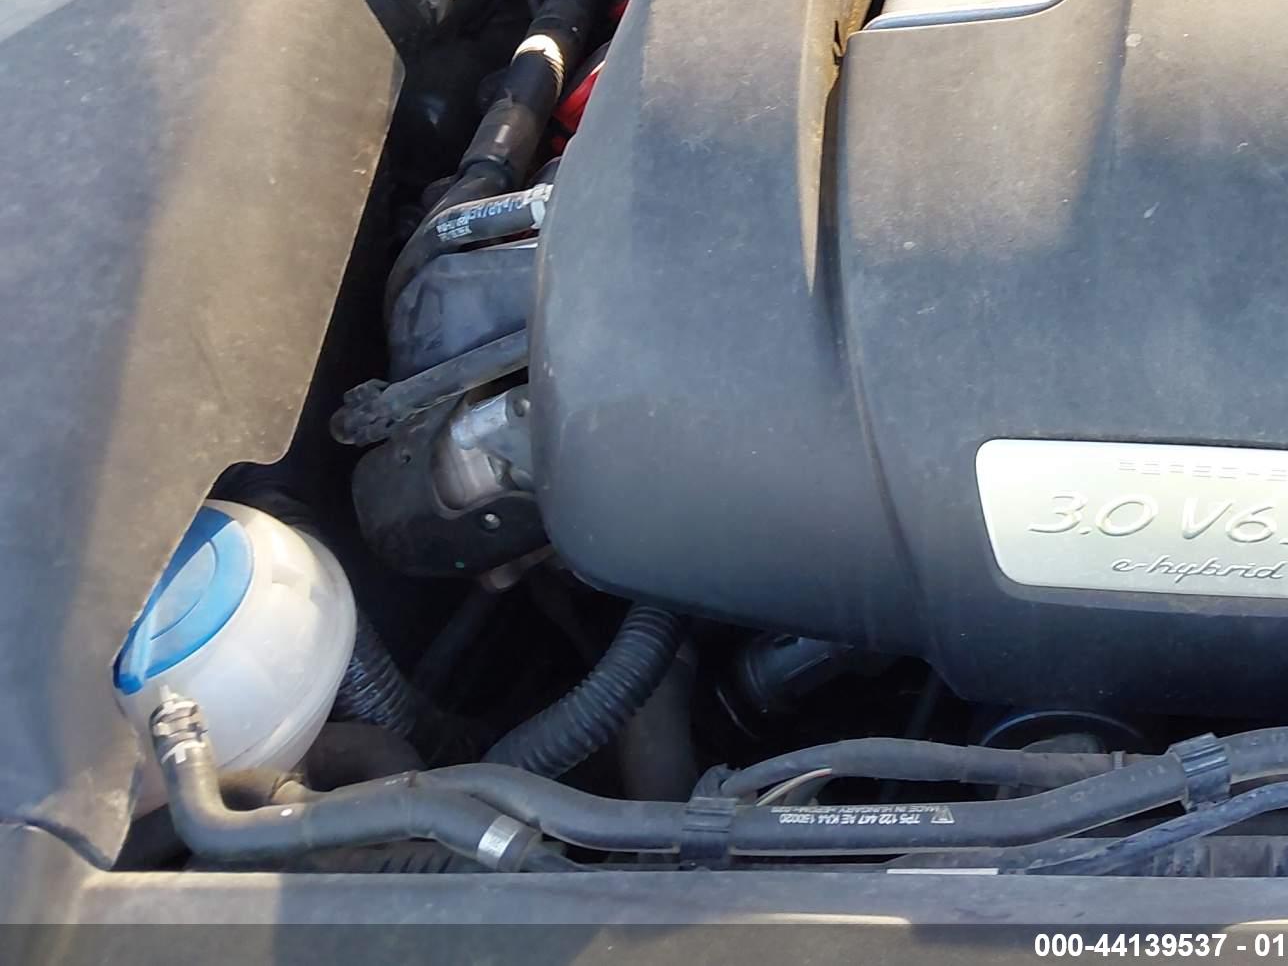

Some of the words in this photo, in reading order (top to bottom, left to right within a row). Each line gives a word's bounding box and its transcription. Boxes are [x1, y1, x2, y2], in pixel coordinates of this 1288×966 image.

[1028, 491, 1160, 537] 3.0
[1180, 496, 1278, 544] V6
[1110, 554, 1288, 584] e-hybrid
